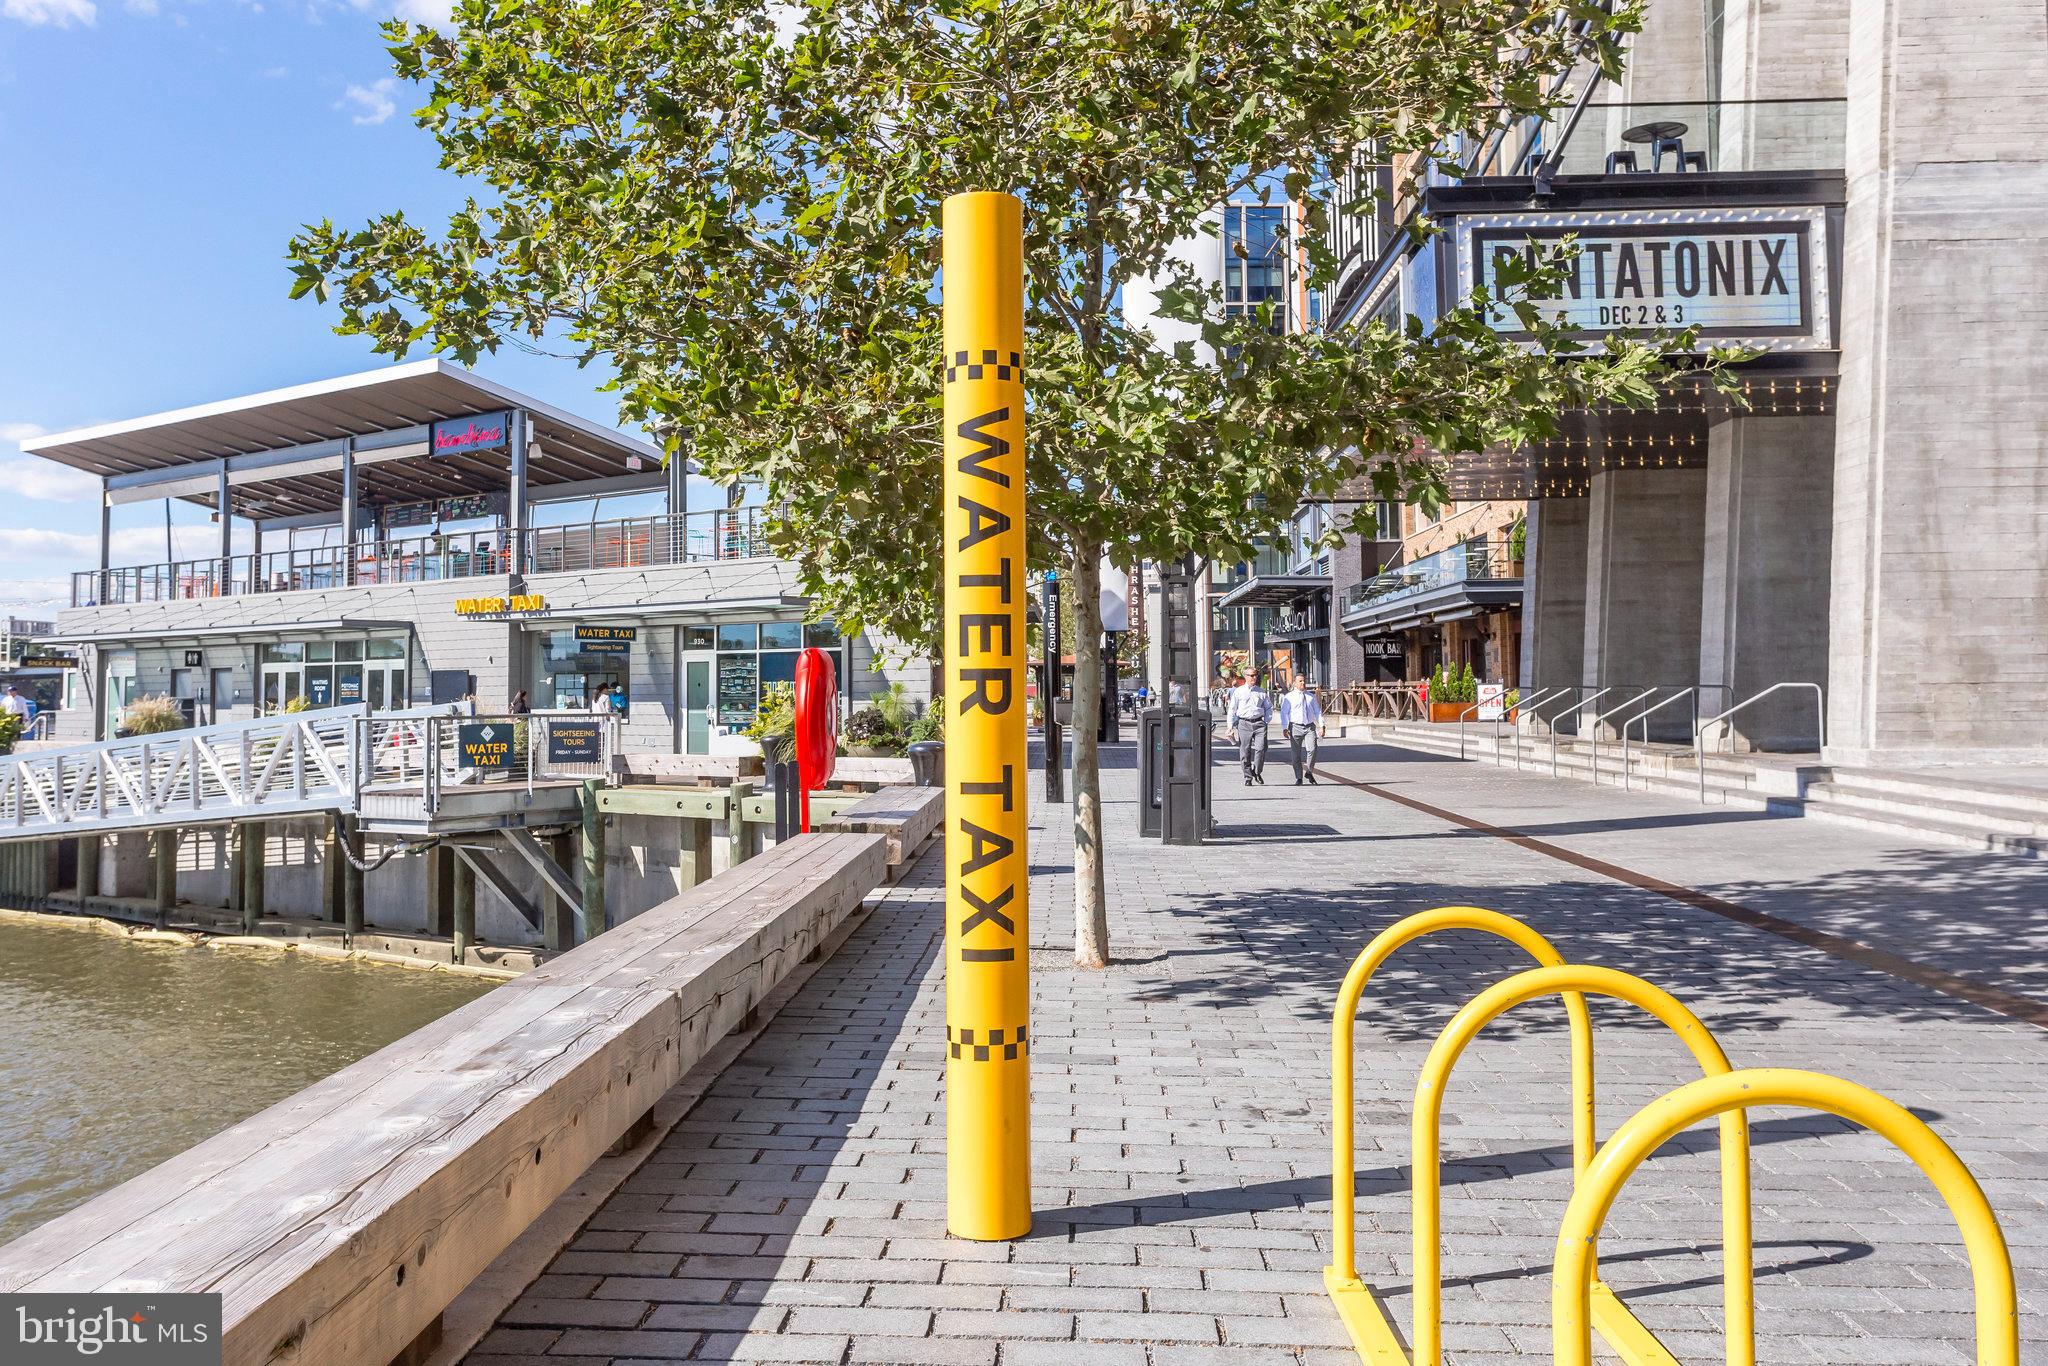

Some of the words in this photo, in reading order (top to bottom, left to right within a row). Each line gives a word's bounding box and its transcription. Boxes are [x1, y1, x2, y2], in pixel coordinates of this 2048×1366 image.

[1494, 239, 1790, 300] PENTATONIX
[1599, 306, 1631, 326] DEC
[1637, 305, 1649, 325] 2
[1655, 305, 1667, 324] &
[1674, 304, 1684, 323] 3
[957, 407, 1012, 717] WATER
[455, 597, 504, 615] WATER
[509, 593, 546, 612] TAXI
[1047, 594, 1058, 654] Emergency
[578, 628, 610, 639] WATER
[613, 629, 635, 640] TAXI
[586, 643, 612, 651] Sightseeing
[1365, 643, 1385, 654] NOOK
[1387, 643, 1402, 654] BAR
[1480, 698, 1502, 708] OPEN
[553, 730, 595, 738] SIGHTSEEING
[563, 738, 585, 746] TOURS
[465, 742, 508, 755] WATER
[473, 754, 501, 766] TAXI
[960, 764, 1015, 962] TAXI
